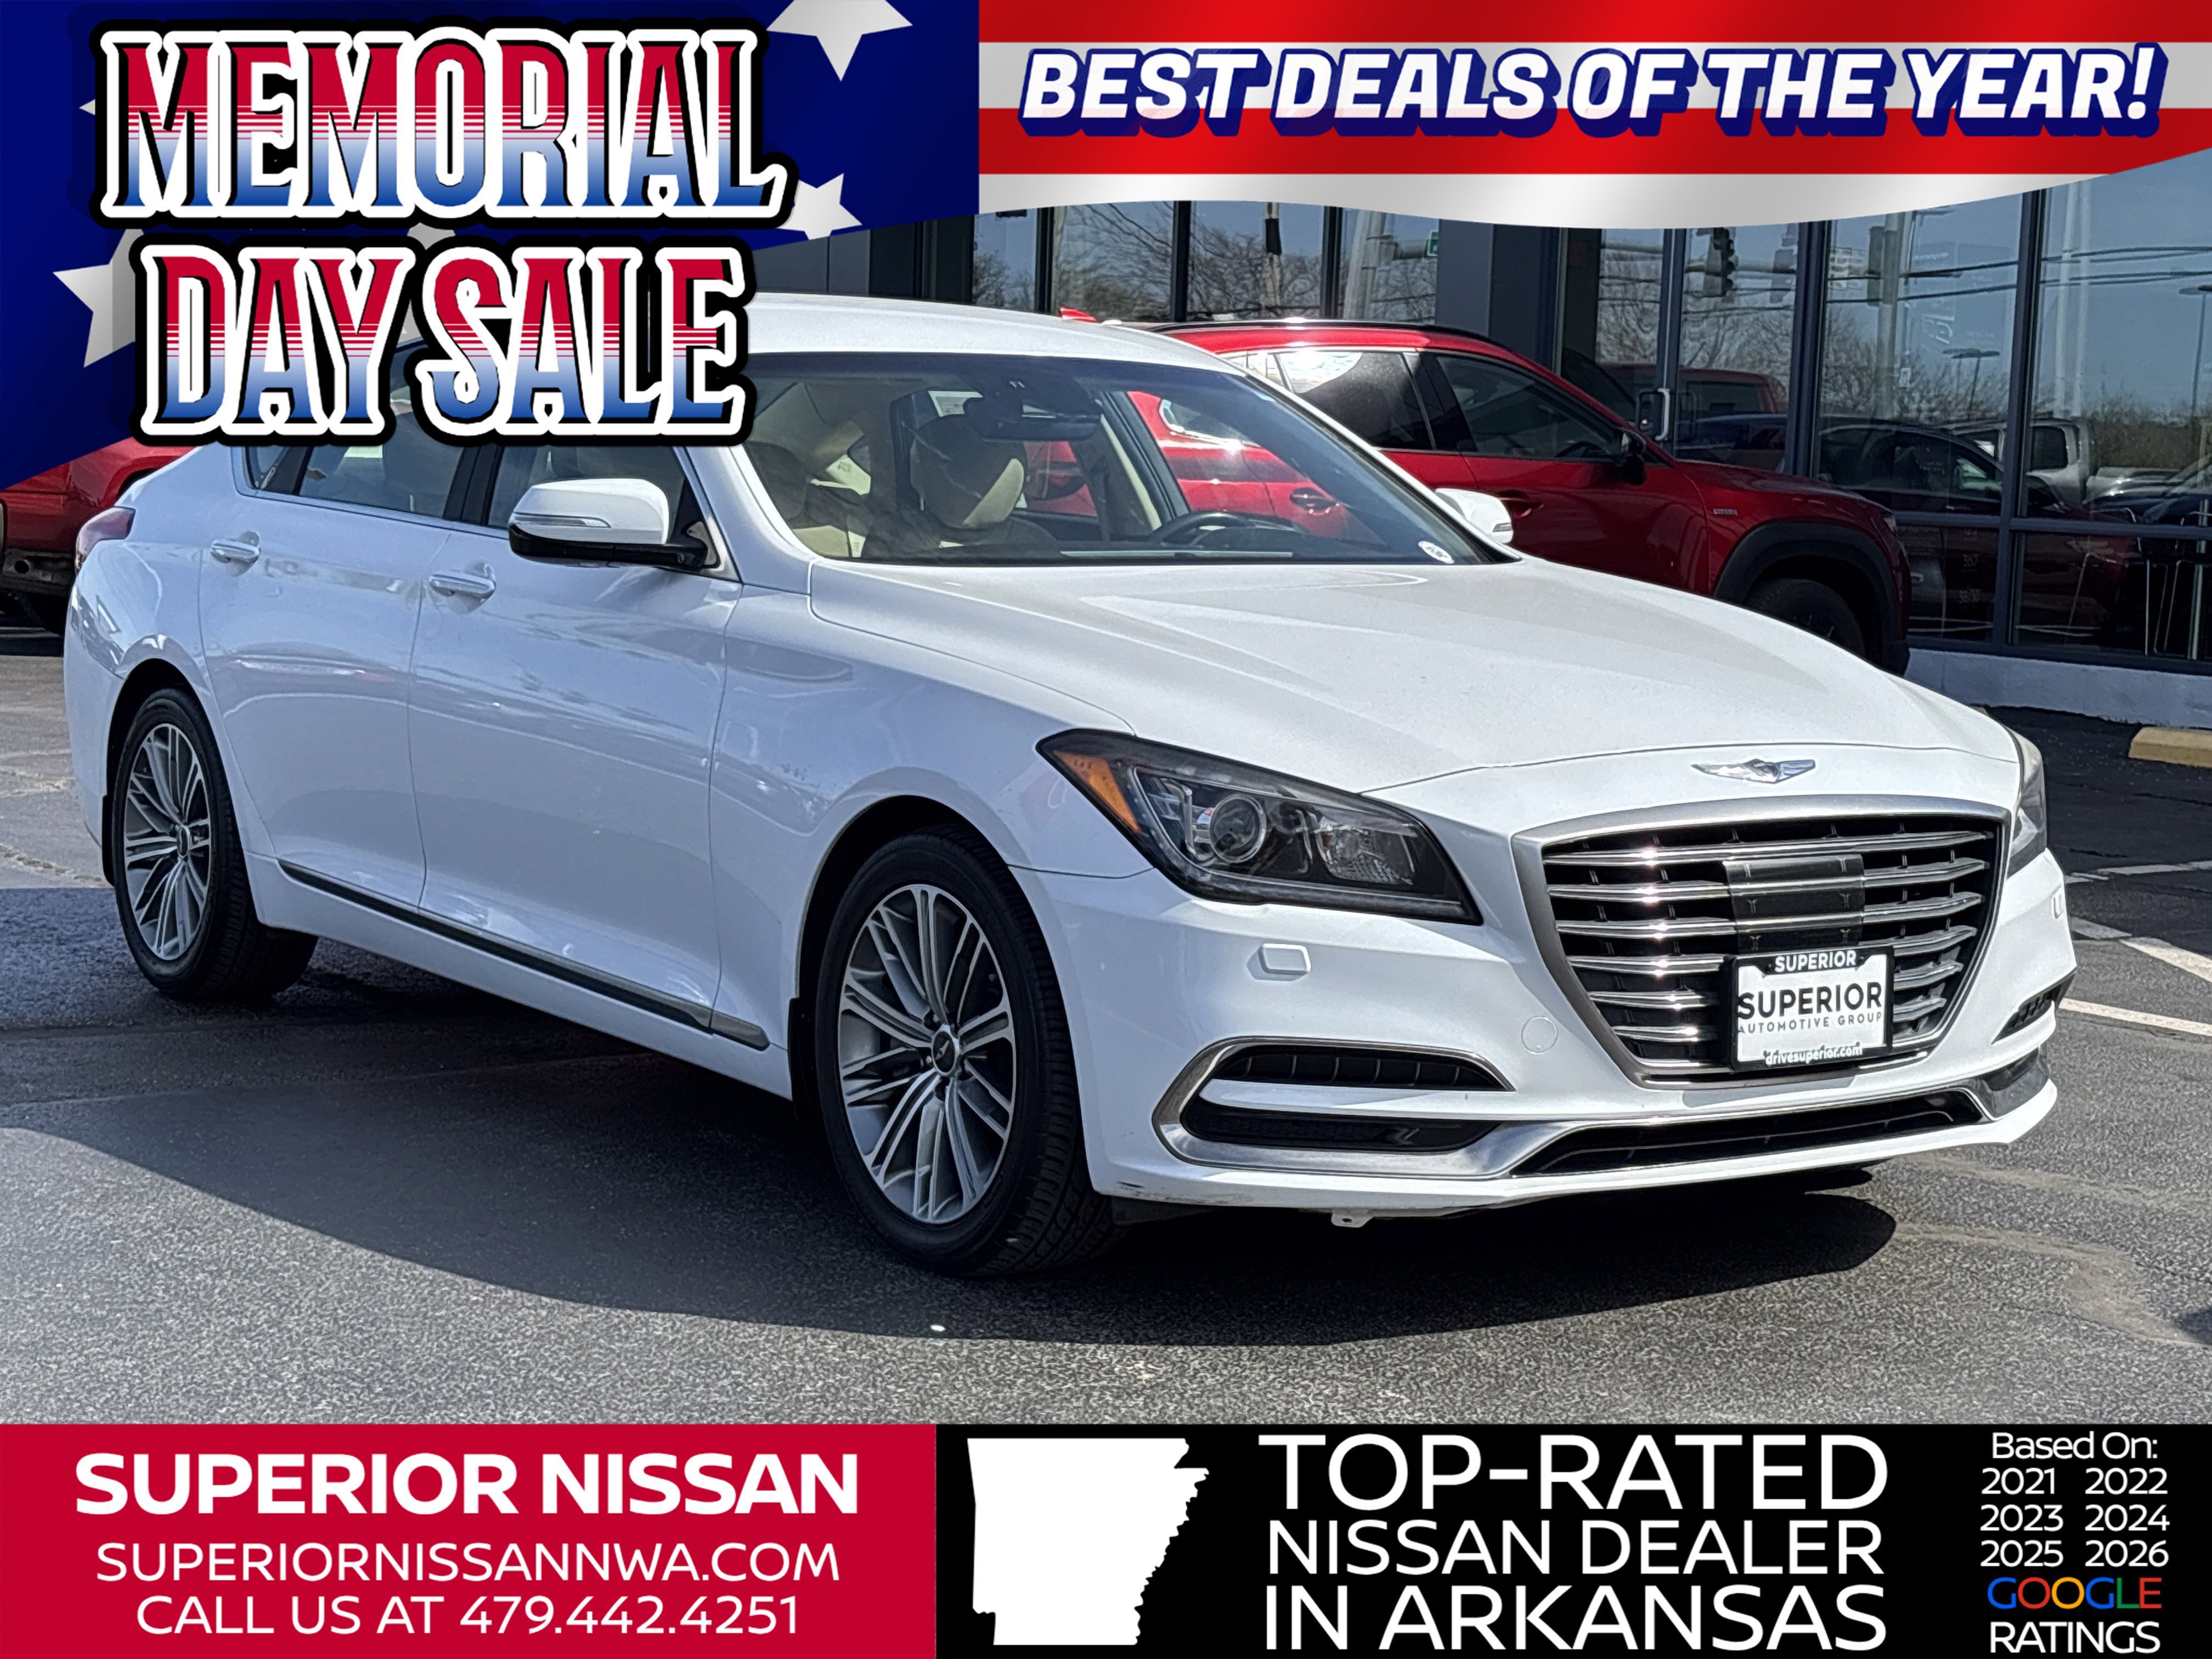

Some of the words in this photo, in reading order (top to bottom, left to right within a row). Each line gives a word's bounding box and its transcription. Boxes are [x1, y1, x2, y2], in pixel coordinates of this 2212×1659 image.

[1775, 950, 1857, 972] SUPERIOR
[1738, 981, 1882, 1019] SUPERIOR
[1738, 1017, 1830, 1033] AUTOMOTIVE
[1838, 1012, 1882, 1025] GROUP
[1765, 1046, 1863, 1065] drivesuperior.com
